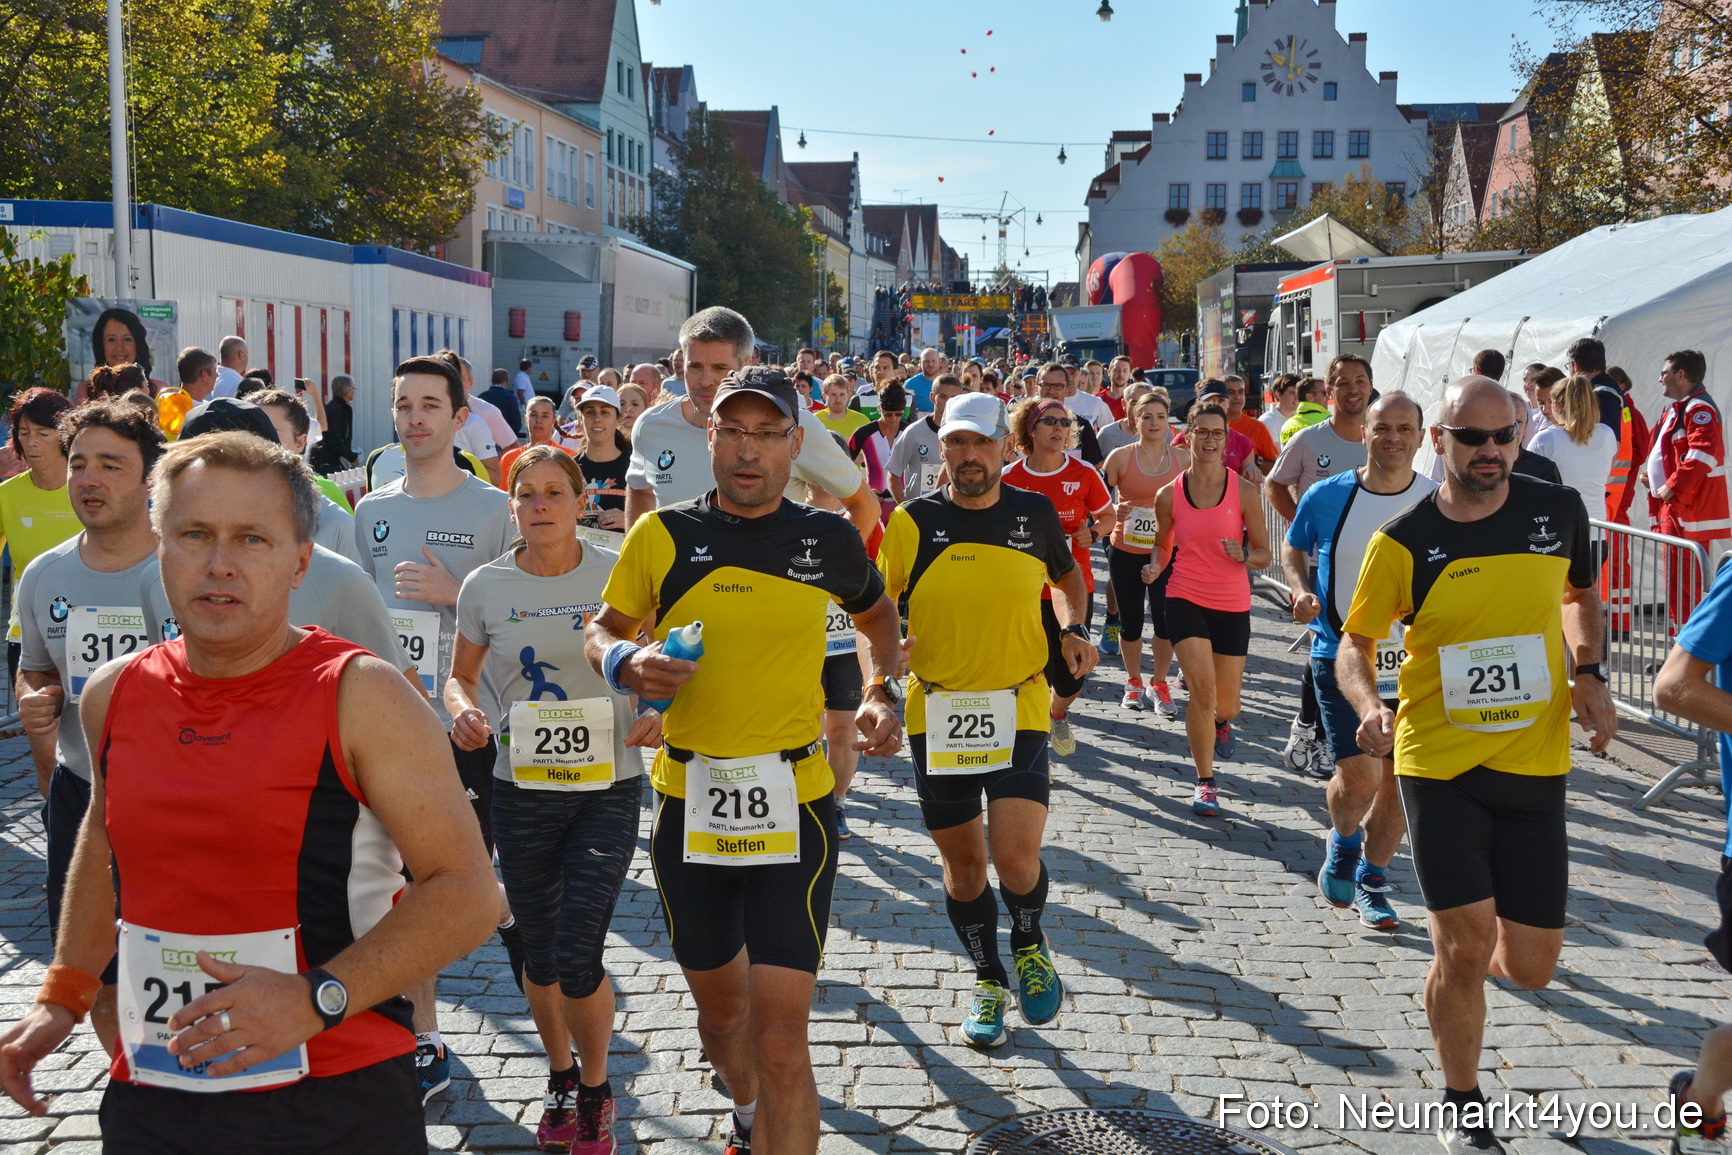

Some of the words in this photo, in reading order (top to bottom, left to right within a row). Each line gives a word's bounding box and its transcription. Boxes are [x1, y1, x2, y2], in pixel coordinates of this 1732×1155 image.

[944, 299, 977, 307] START
[1134, 519, 1156, 532] 203
[1533, 516, 1549, 524] TSV
[426, 531, 474, 546] BOCK
[801, 538, 818, 546] TSV
[1007, 540, 1034, 549] Burgthann
[1529, 541, 1562, 554] Burgthann
[1427, 553, 1447, 562] erima
[787, 568, 824, 581] Burgthann
[1448, 567, 1480, 579] Vlatko
[713, 583, 753, 592] Steffen
[98, 615, 143, 626] BOCK
[1470, 645, 1515, 660] BOCK
[1467, 663, 1520, 694] 231
[952, 698, 990, 707] BOCK
[1490, 695, 1521, 704] Neumarkt
[539, 708, 584, 719] BOCK
[1480, 709, 1520, 722] Vlatko
[948, 714, 995, 739] 225
[534, 726, 590, 755] 239
[957, 754, 988, 765] Bernd
[547, 769, 581, 781] Heike
[710, 765, 758, 780] BOCK
[708, 787, 769, 819] 218
[709, 822, 728, 831] PARTL
[729, 823, 764, 832] Neumarkt
[717, 838, 765, 853] Steffen
[162, 948, 238, 967] BOK
